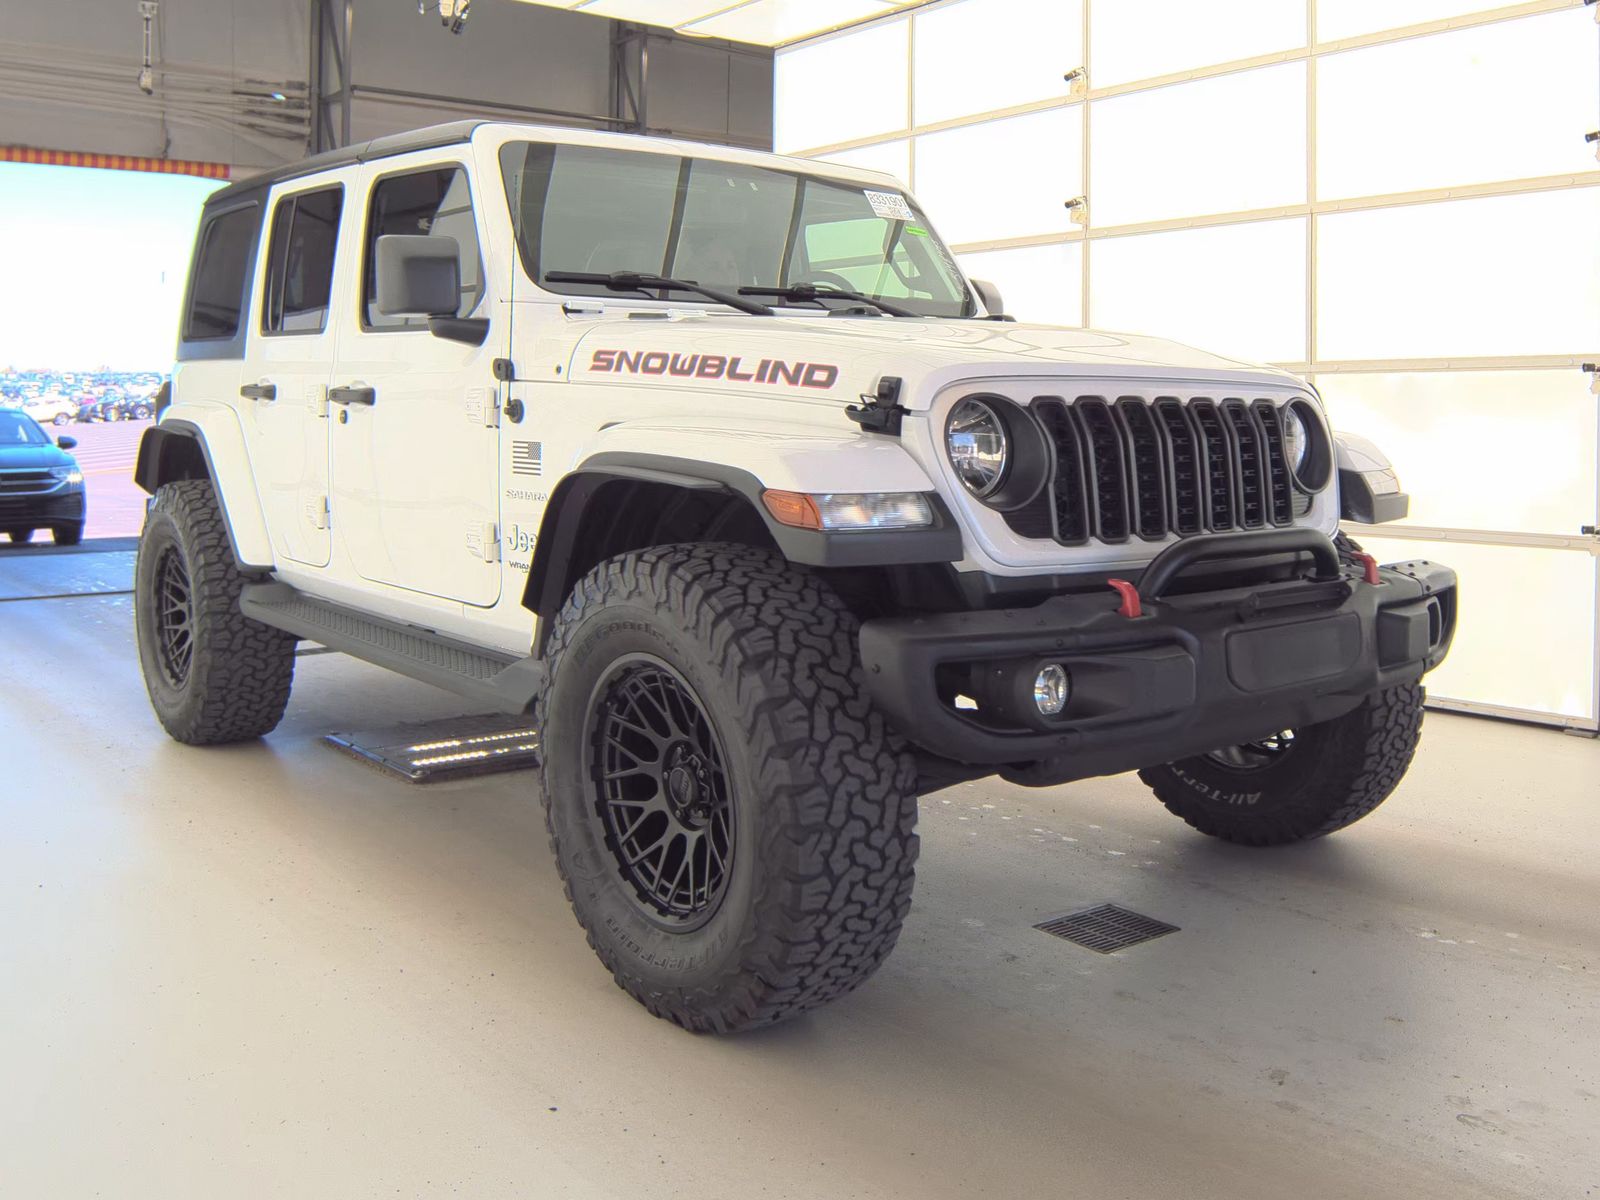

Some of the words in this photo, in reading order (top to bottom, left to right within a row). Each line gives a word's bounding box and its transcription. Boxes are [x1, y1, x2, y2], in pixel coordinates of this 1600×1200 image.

[588, 349, 839, 389] SNOWBLIND
[506, 489, 549, 501] SAHARA
[507, 524, 538, 552] Jee
[1166, 760, 1262, 805] All-Terr
